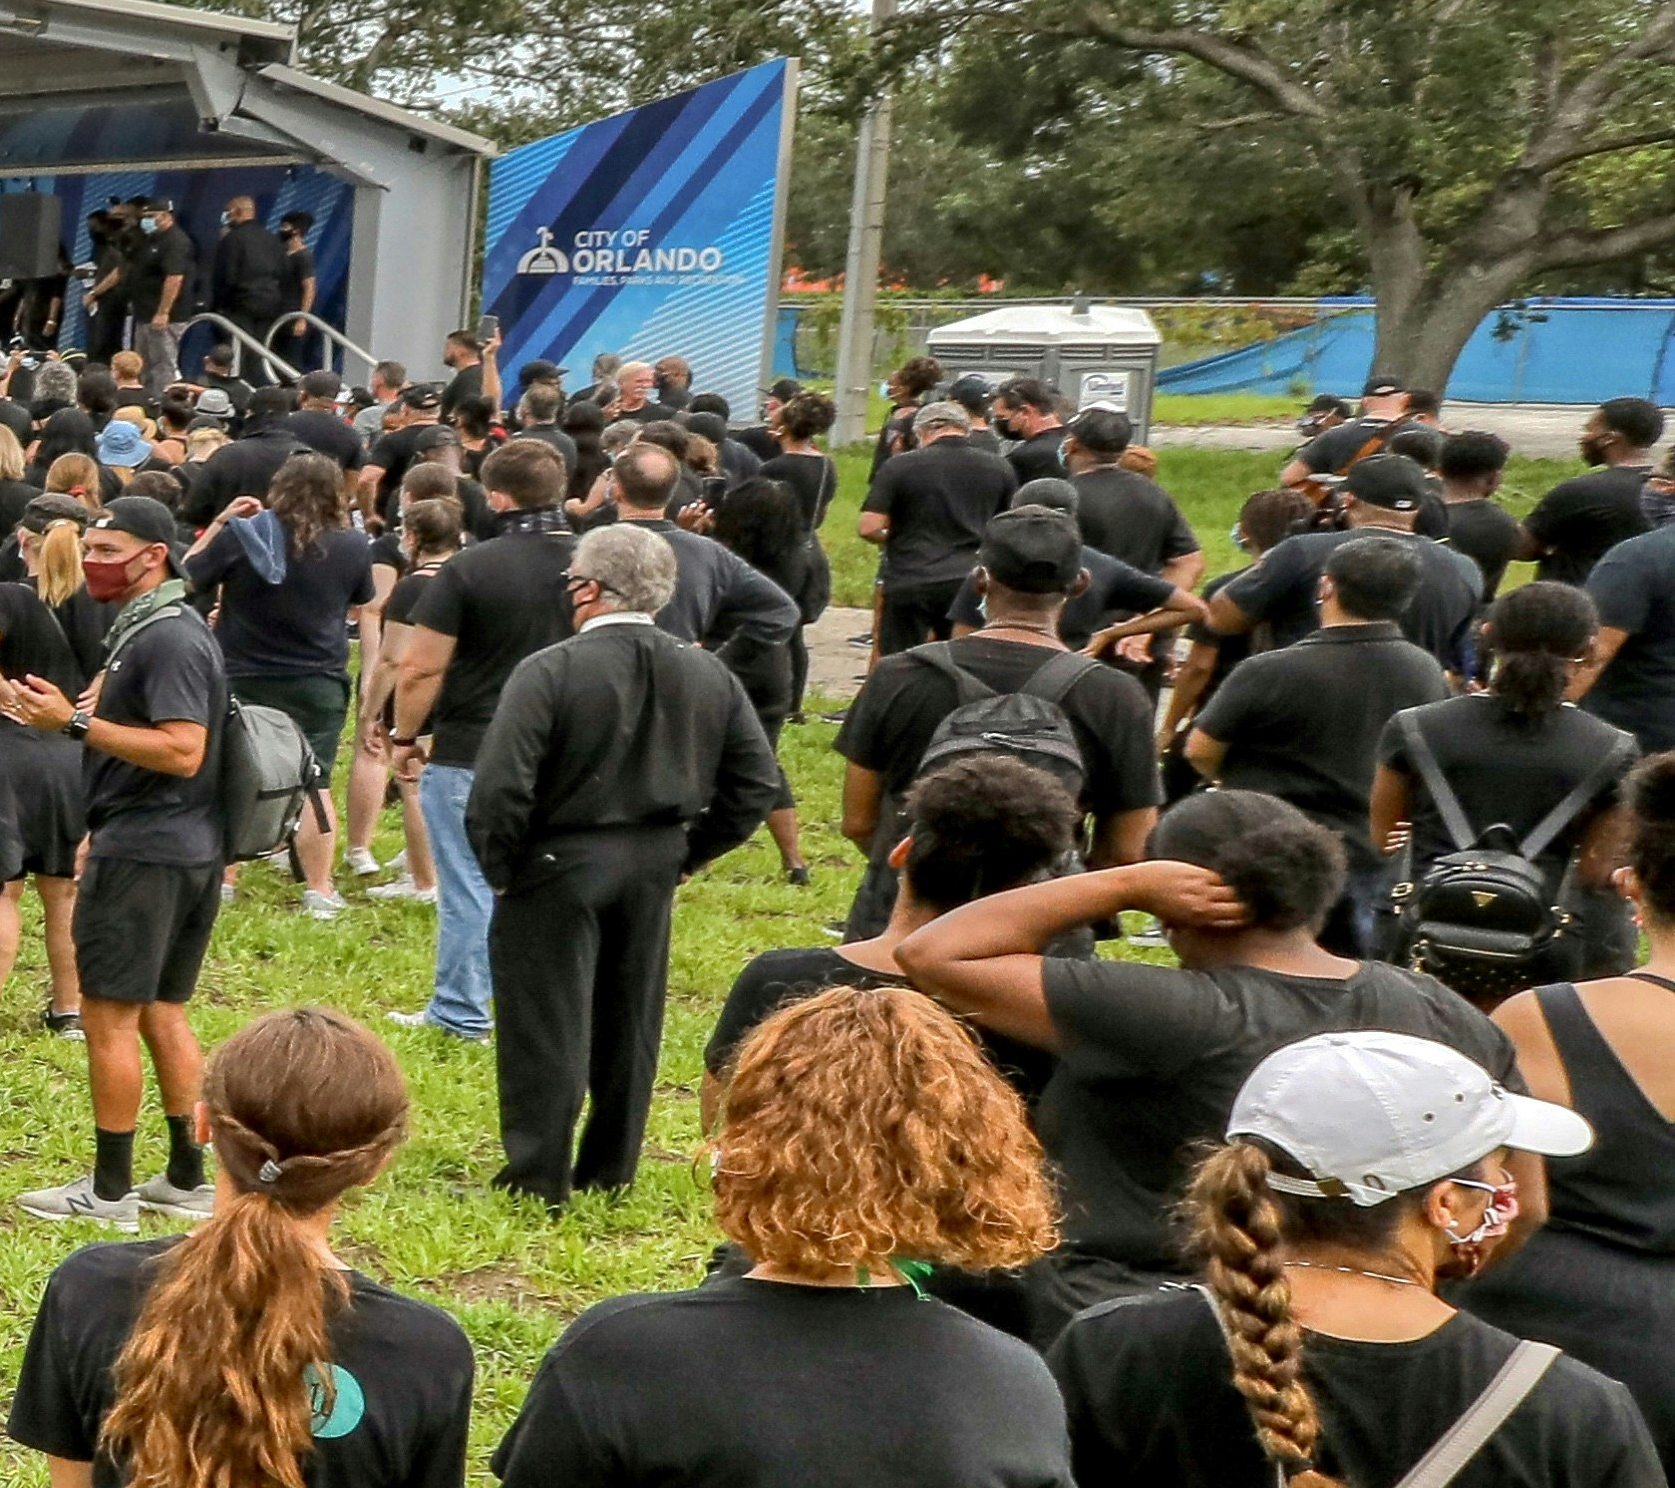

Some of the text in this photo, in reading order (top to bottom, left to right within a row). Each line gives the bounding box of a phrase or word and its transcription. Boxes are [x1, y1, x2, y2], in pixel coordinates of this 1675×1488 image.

[575, 229, 651, 248] CITY OF
[573, 248, 723, 273] ORLANDO
